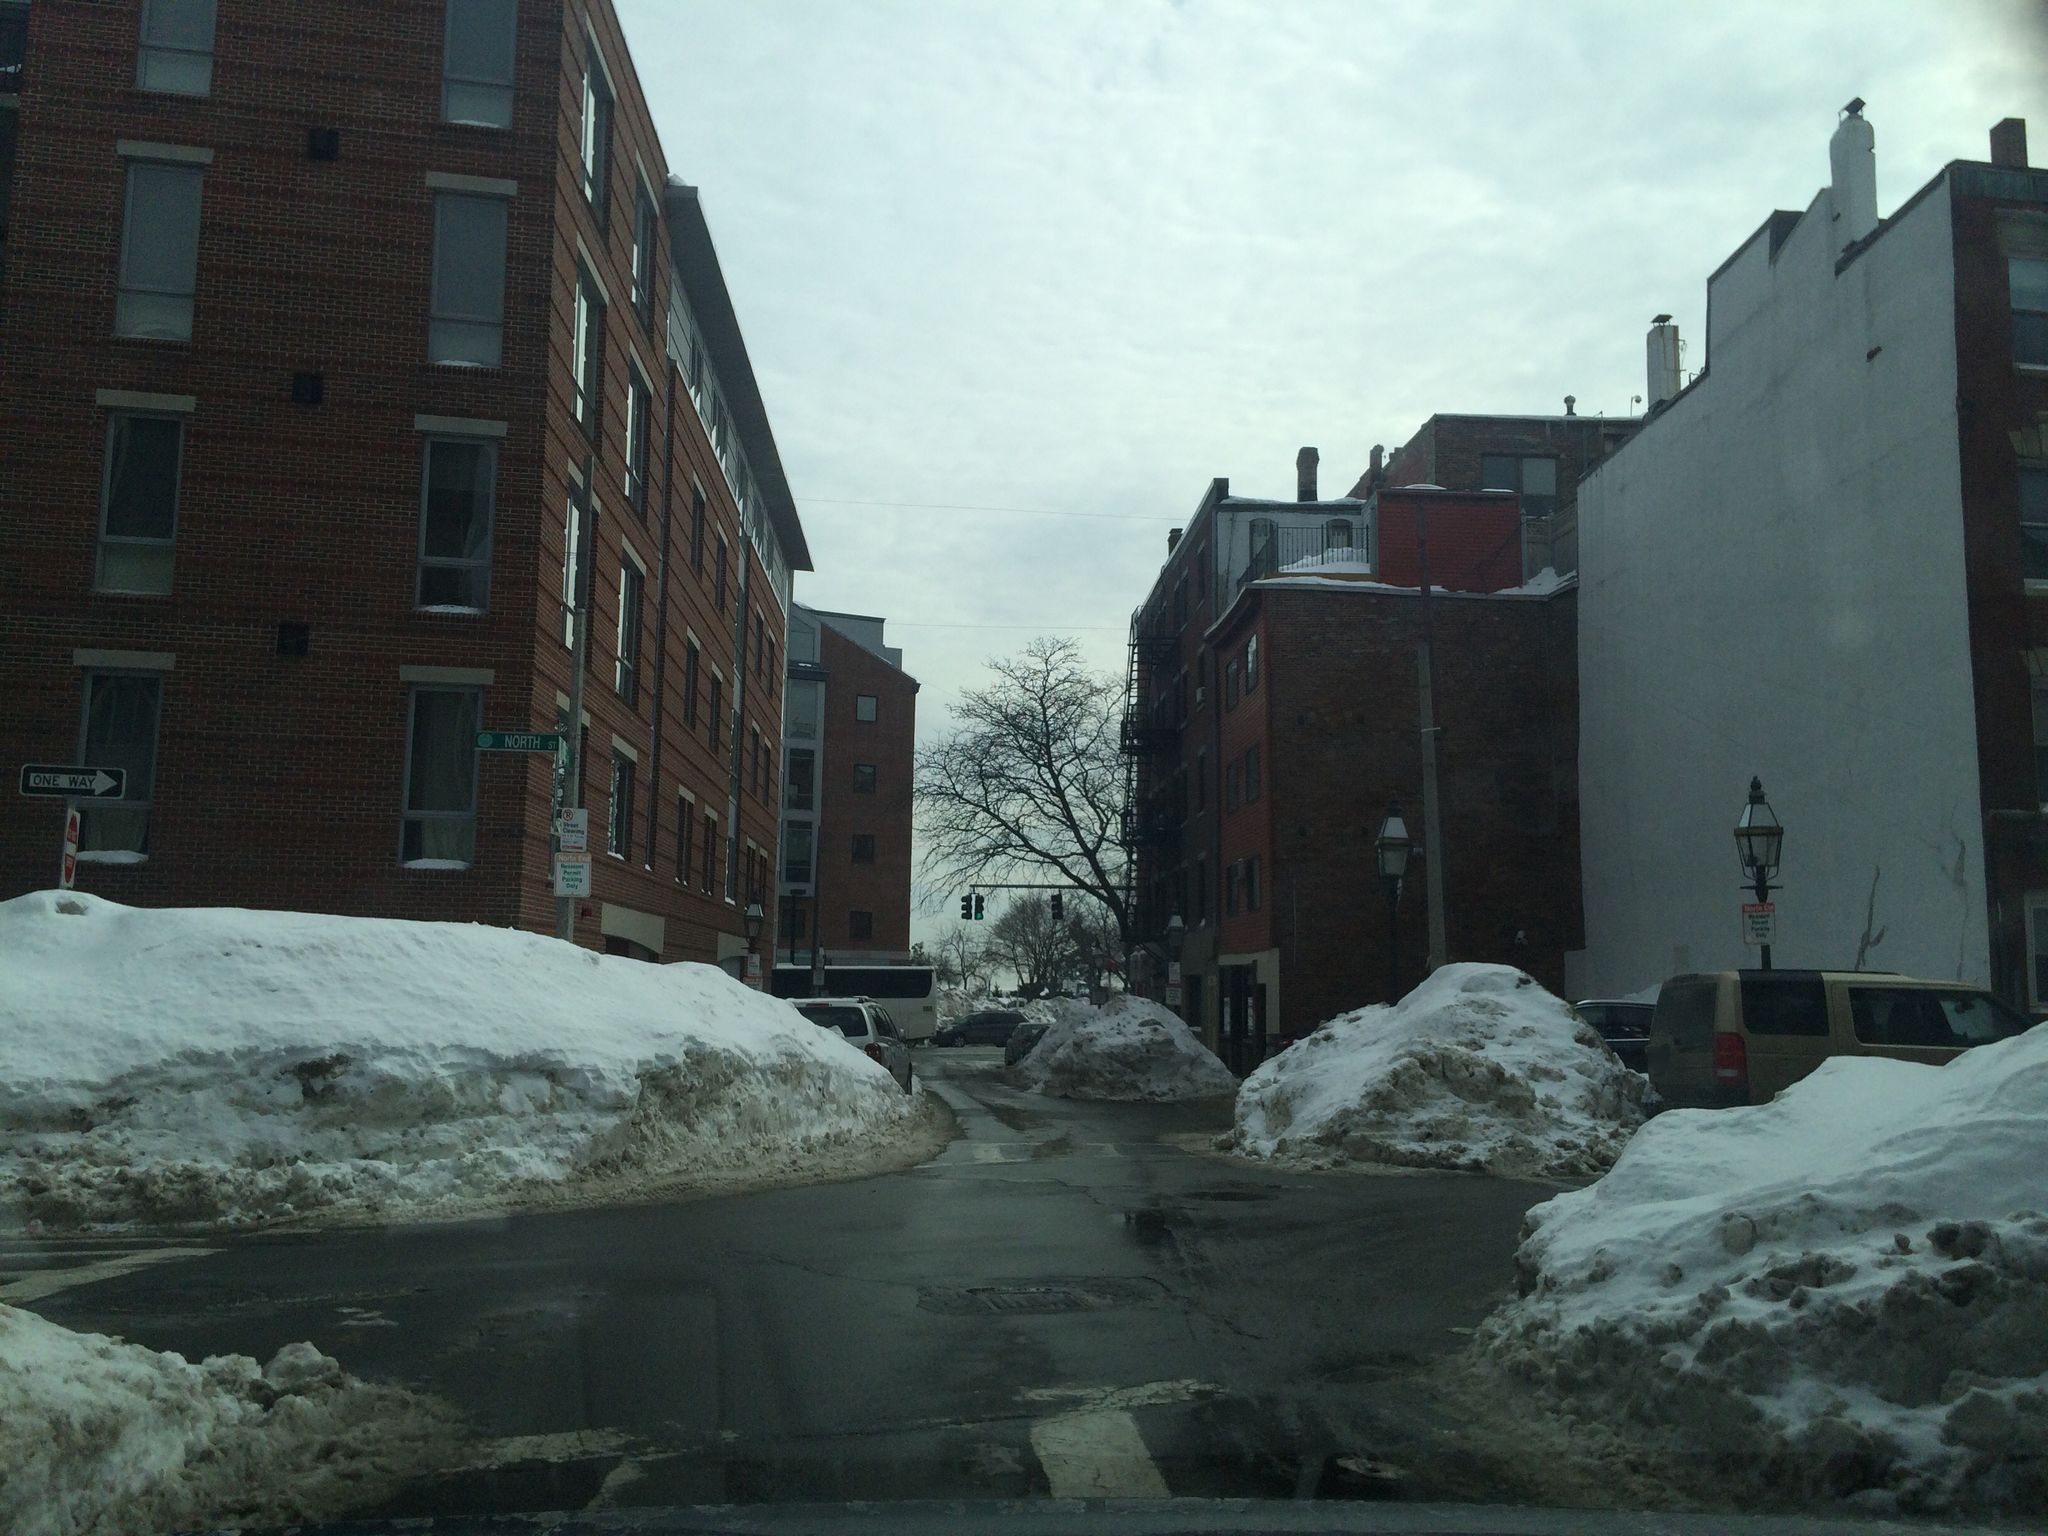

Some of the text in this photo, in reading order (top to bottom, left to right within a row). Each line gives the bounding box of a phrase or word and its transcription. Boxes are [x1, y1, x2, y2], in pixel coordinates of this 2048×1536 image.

[504, 734, 557, 750] NORTH ST
[33, 774, 96, 787] ONE WAY
